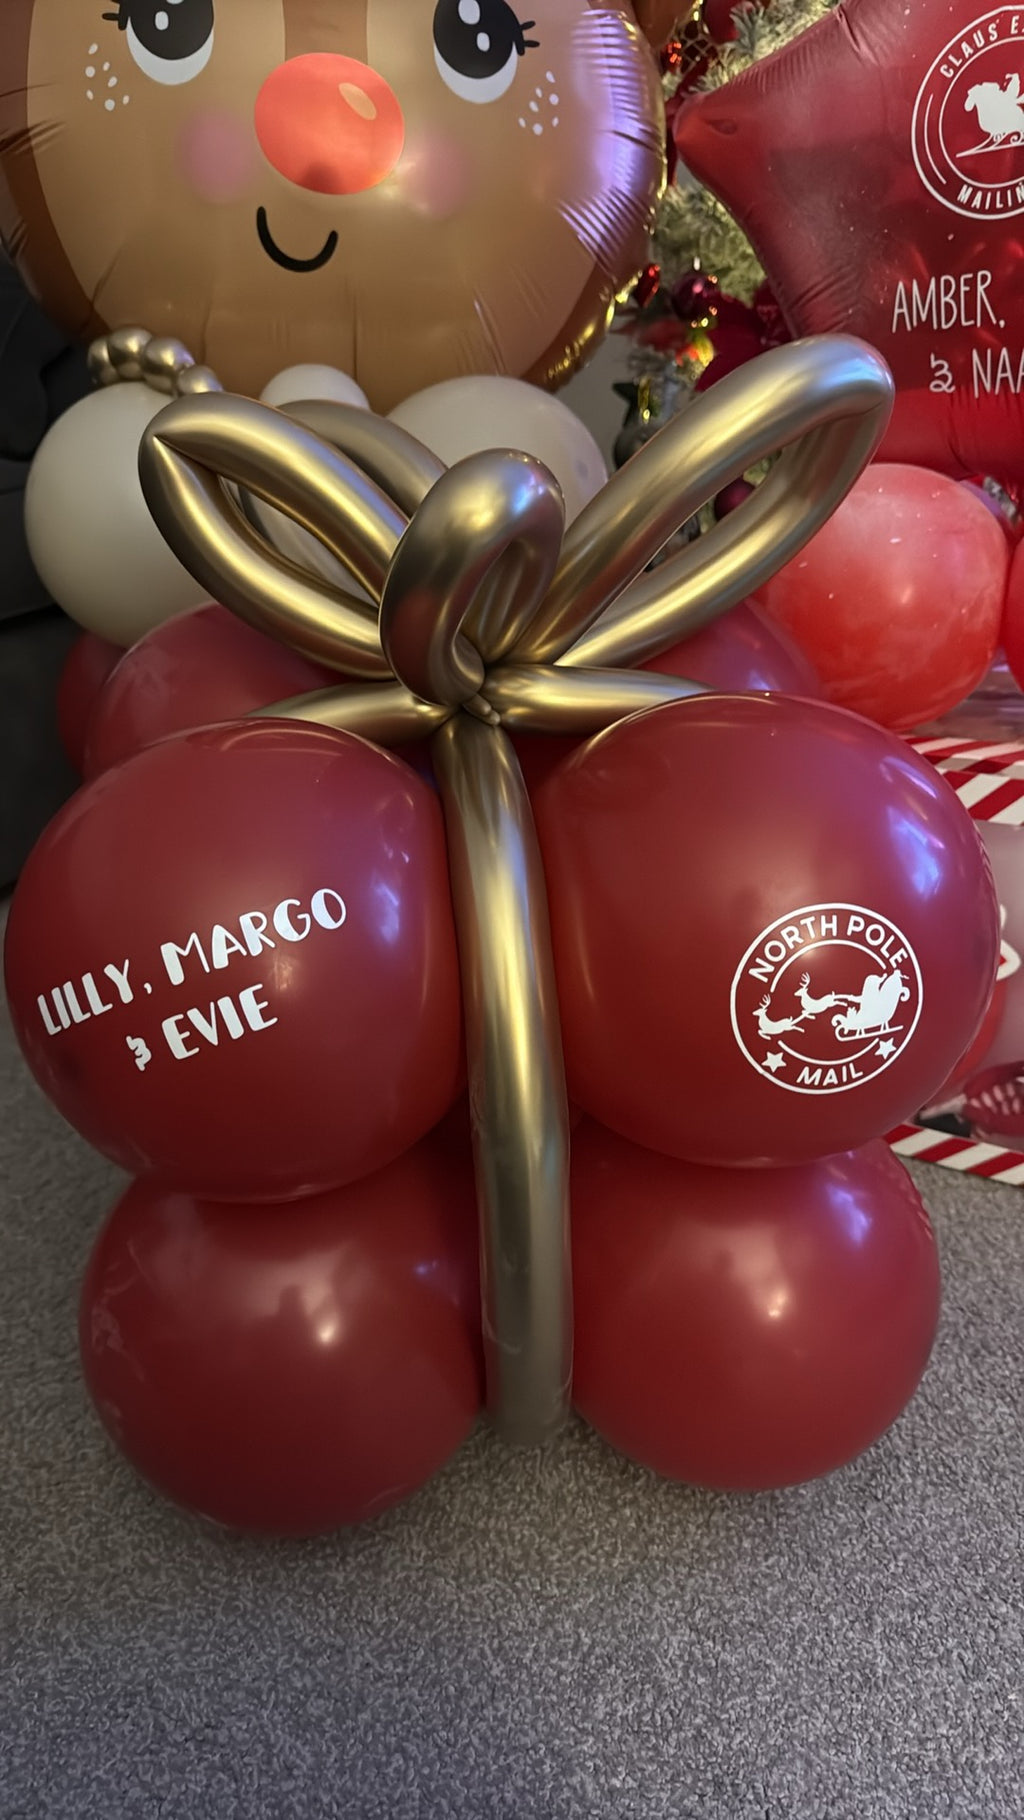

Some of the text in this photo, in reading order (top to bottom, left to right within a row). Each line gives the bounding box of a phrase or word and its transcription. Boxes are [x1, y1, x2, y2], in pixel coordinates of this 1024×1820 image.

[37, 888, 347, 1036] LILLY, MARGO
[749, 915, 909, 983] NORTH POLE
[161, 984, 278, 1060] EVIE
[796, 1063, 863, 1086] MAIL
